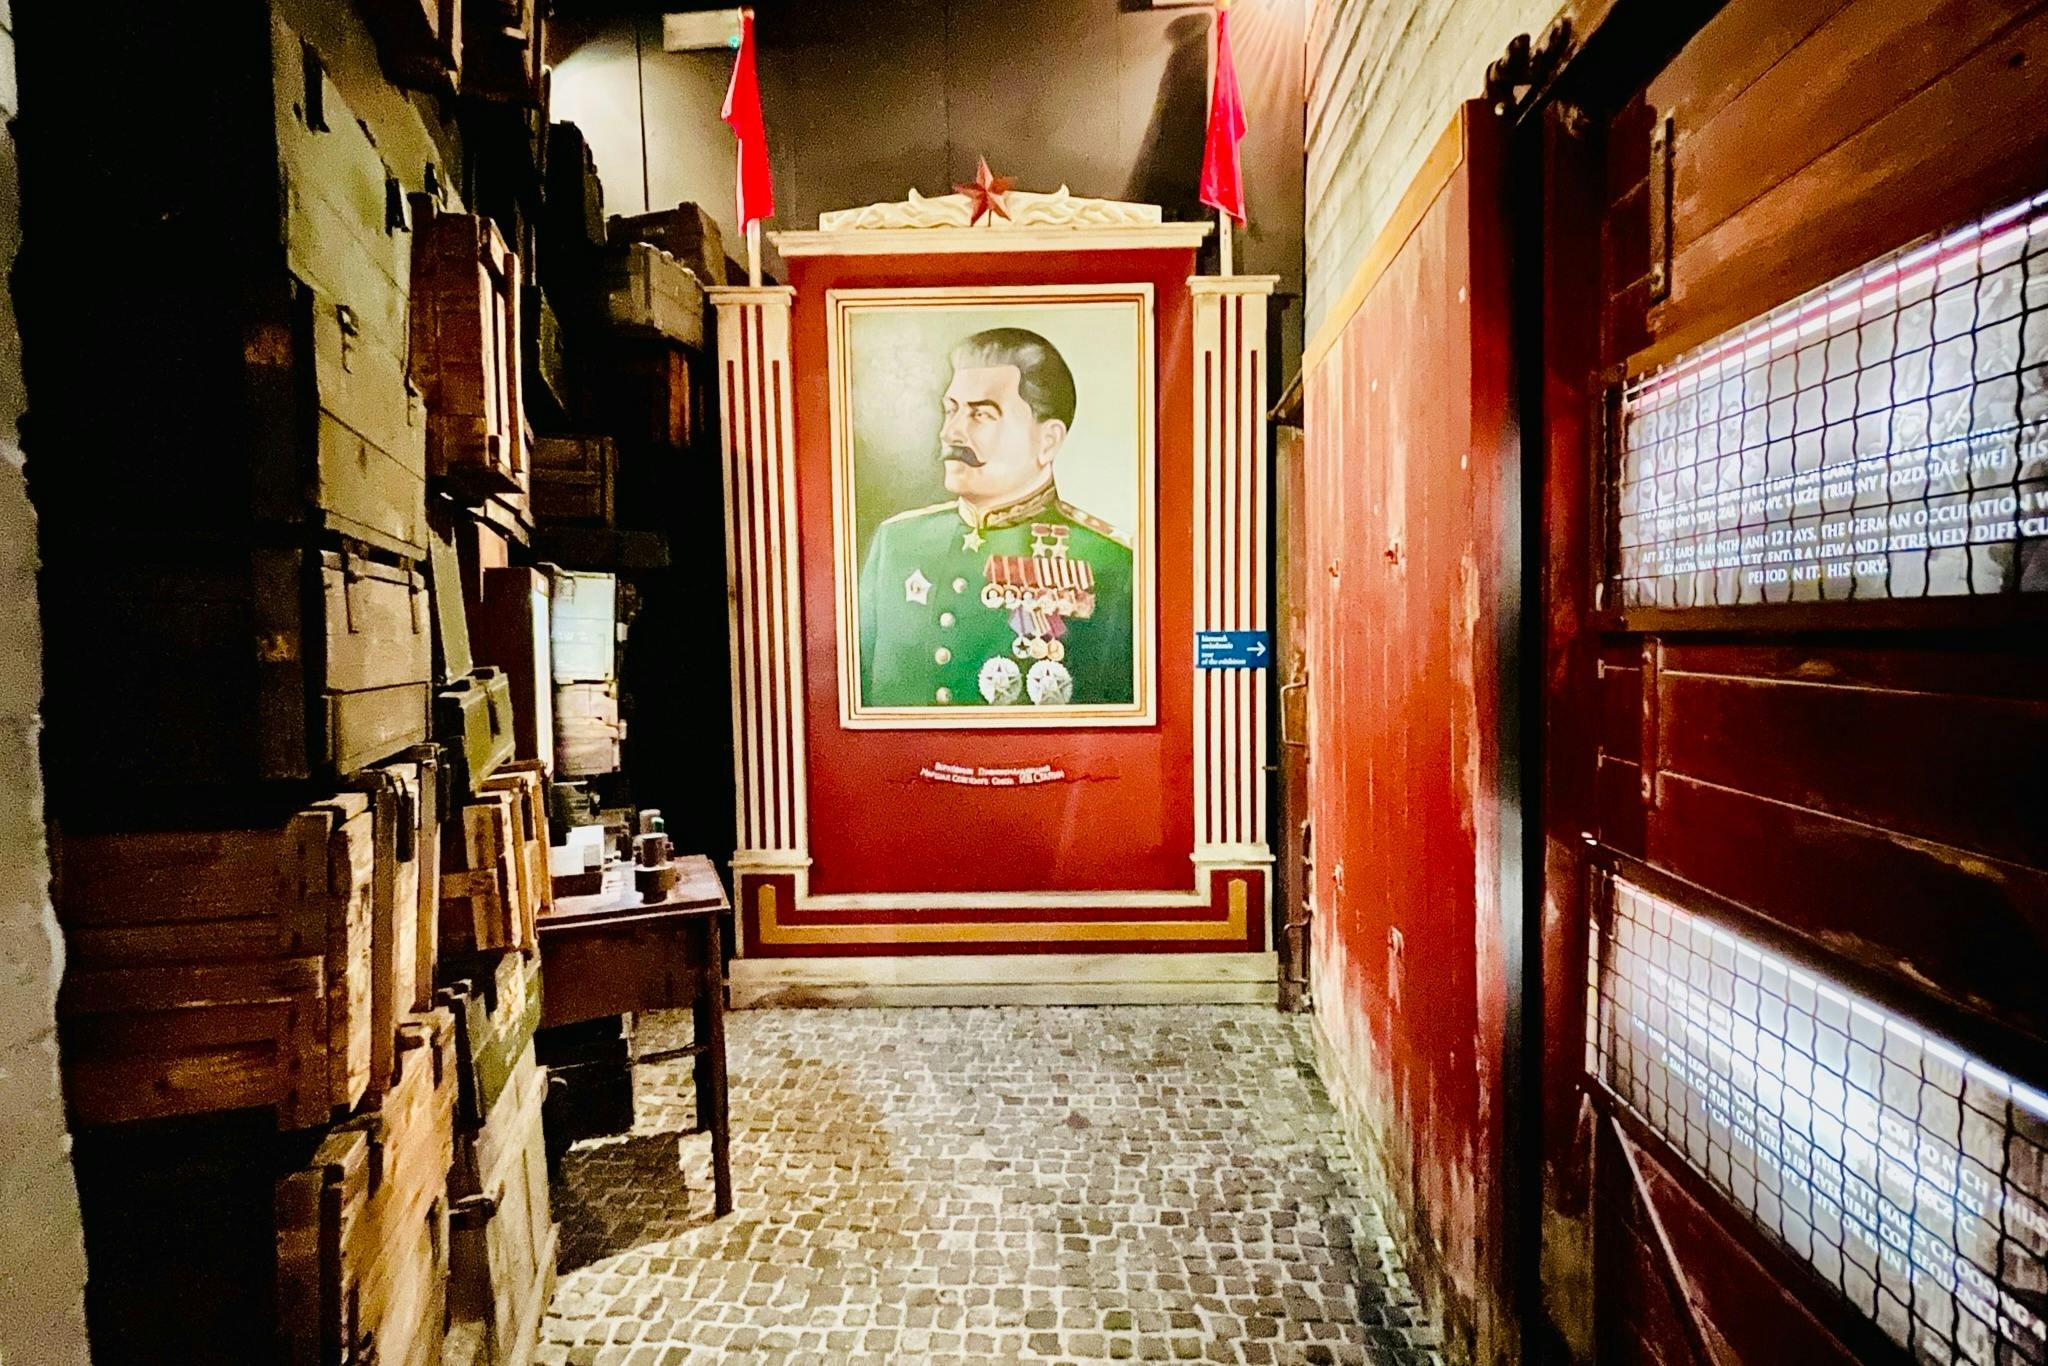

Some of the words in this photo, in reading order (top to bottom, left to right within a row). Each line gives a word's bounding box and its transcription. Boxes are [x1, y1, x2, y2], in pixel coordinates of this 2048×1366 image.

[1671, 545, 1694, 559] EARS
[1771, 530, 1784, 545] 12
[1822, 521, 1846, 538] THE
[1848, 512, 1911, 534] GERMAN
[1804, 544, 1813, 560] A
[1846, 538, 1879, 555] AND
[1975, 517, 2048, 541] DIFFCU
[1827, 558, 1889, 578] HISORY.
[1669, 1057, 1694, 1086] SMAL
[1758, 1127, 1790, 1162] YIED
[1942, 1155, 1988, 1195] NCH
